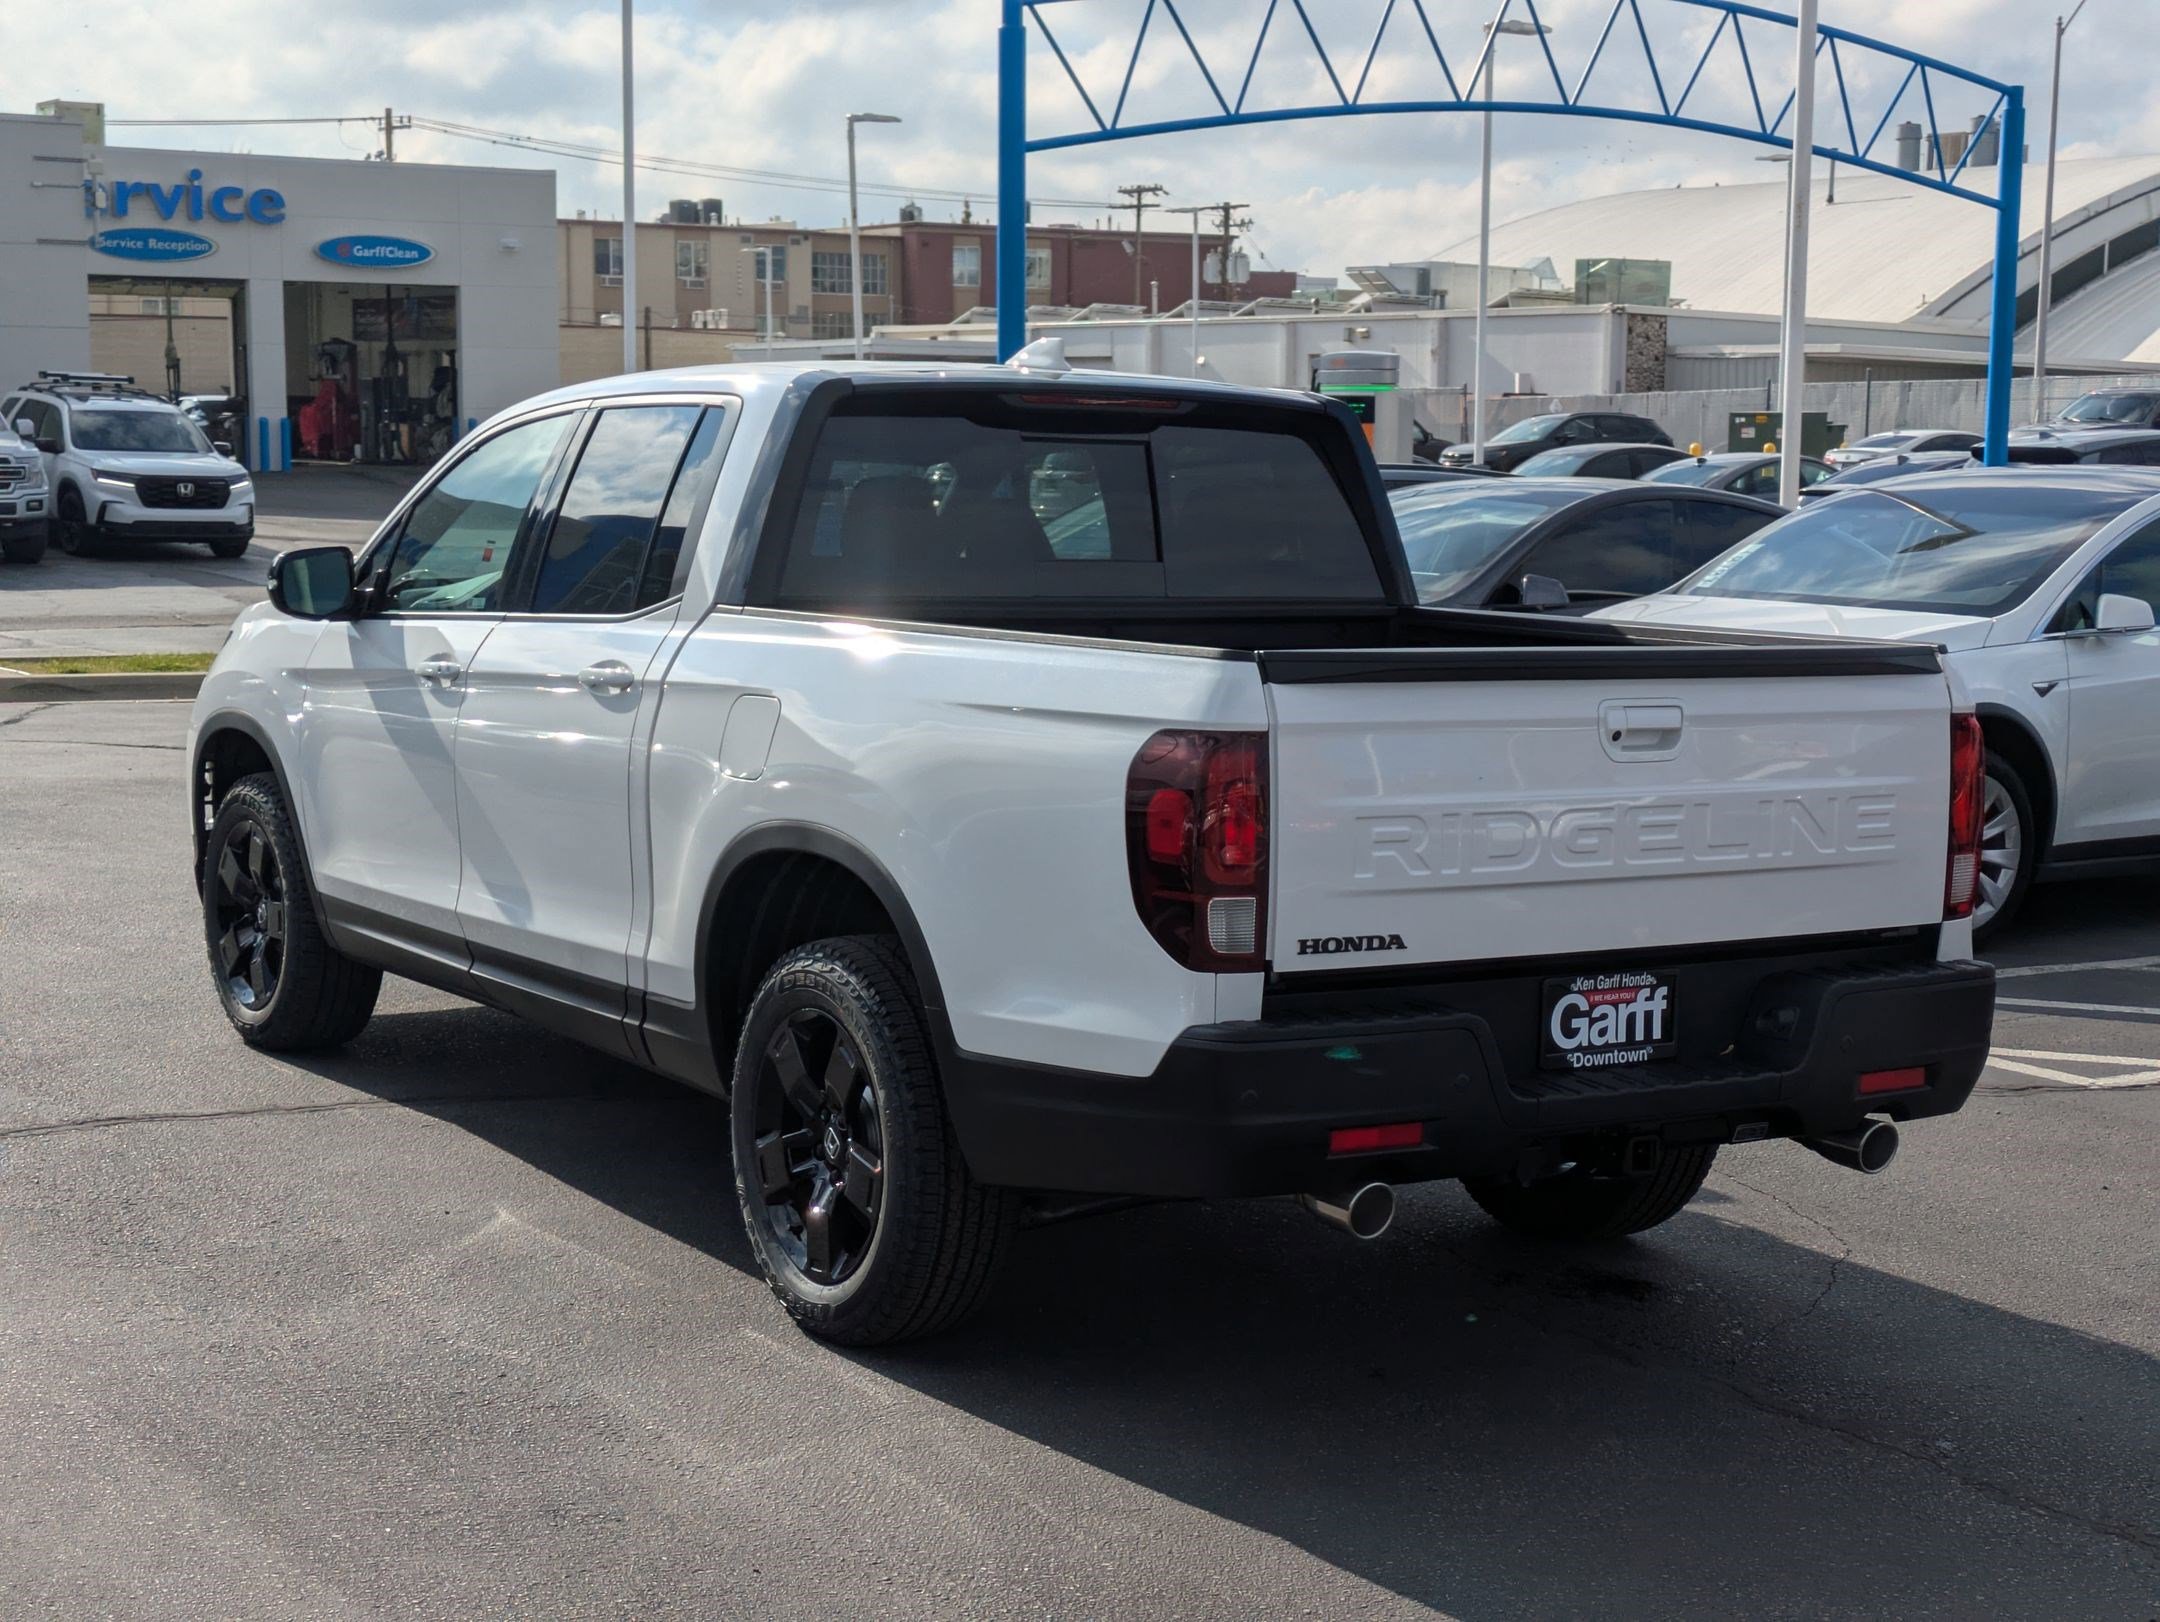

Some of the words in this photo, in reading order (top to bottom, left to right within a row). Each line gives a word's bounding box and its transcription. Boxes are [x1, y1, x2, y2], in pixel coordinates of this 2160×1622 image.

[97, 236, 144, 249] Service
[149, 238, 209, 252] Reception
[353, 245, 418, 259] GarffClean
[1354, 793, 1896, 879] RIDGELINE
[1297, 934, 1408, 955] HONDA
[1576, 976, 1595, 991] Ken
[1597, 974, 1620, 990] Garff
[1622, 972, 1651, 988] Honda
[1551, 986, 1668, 1050] Garff
[1573, 1049, 1648, 1068] Downtown
